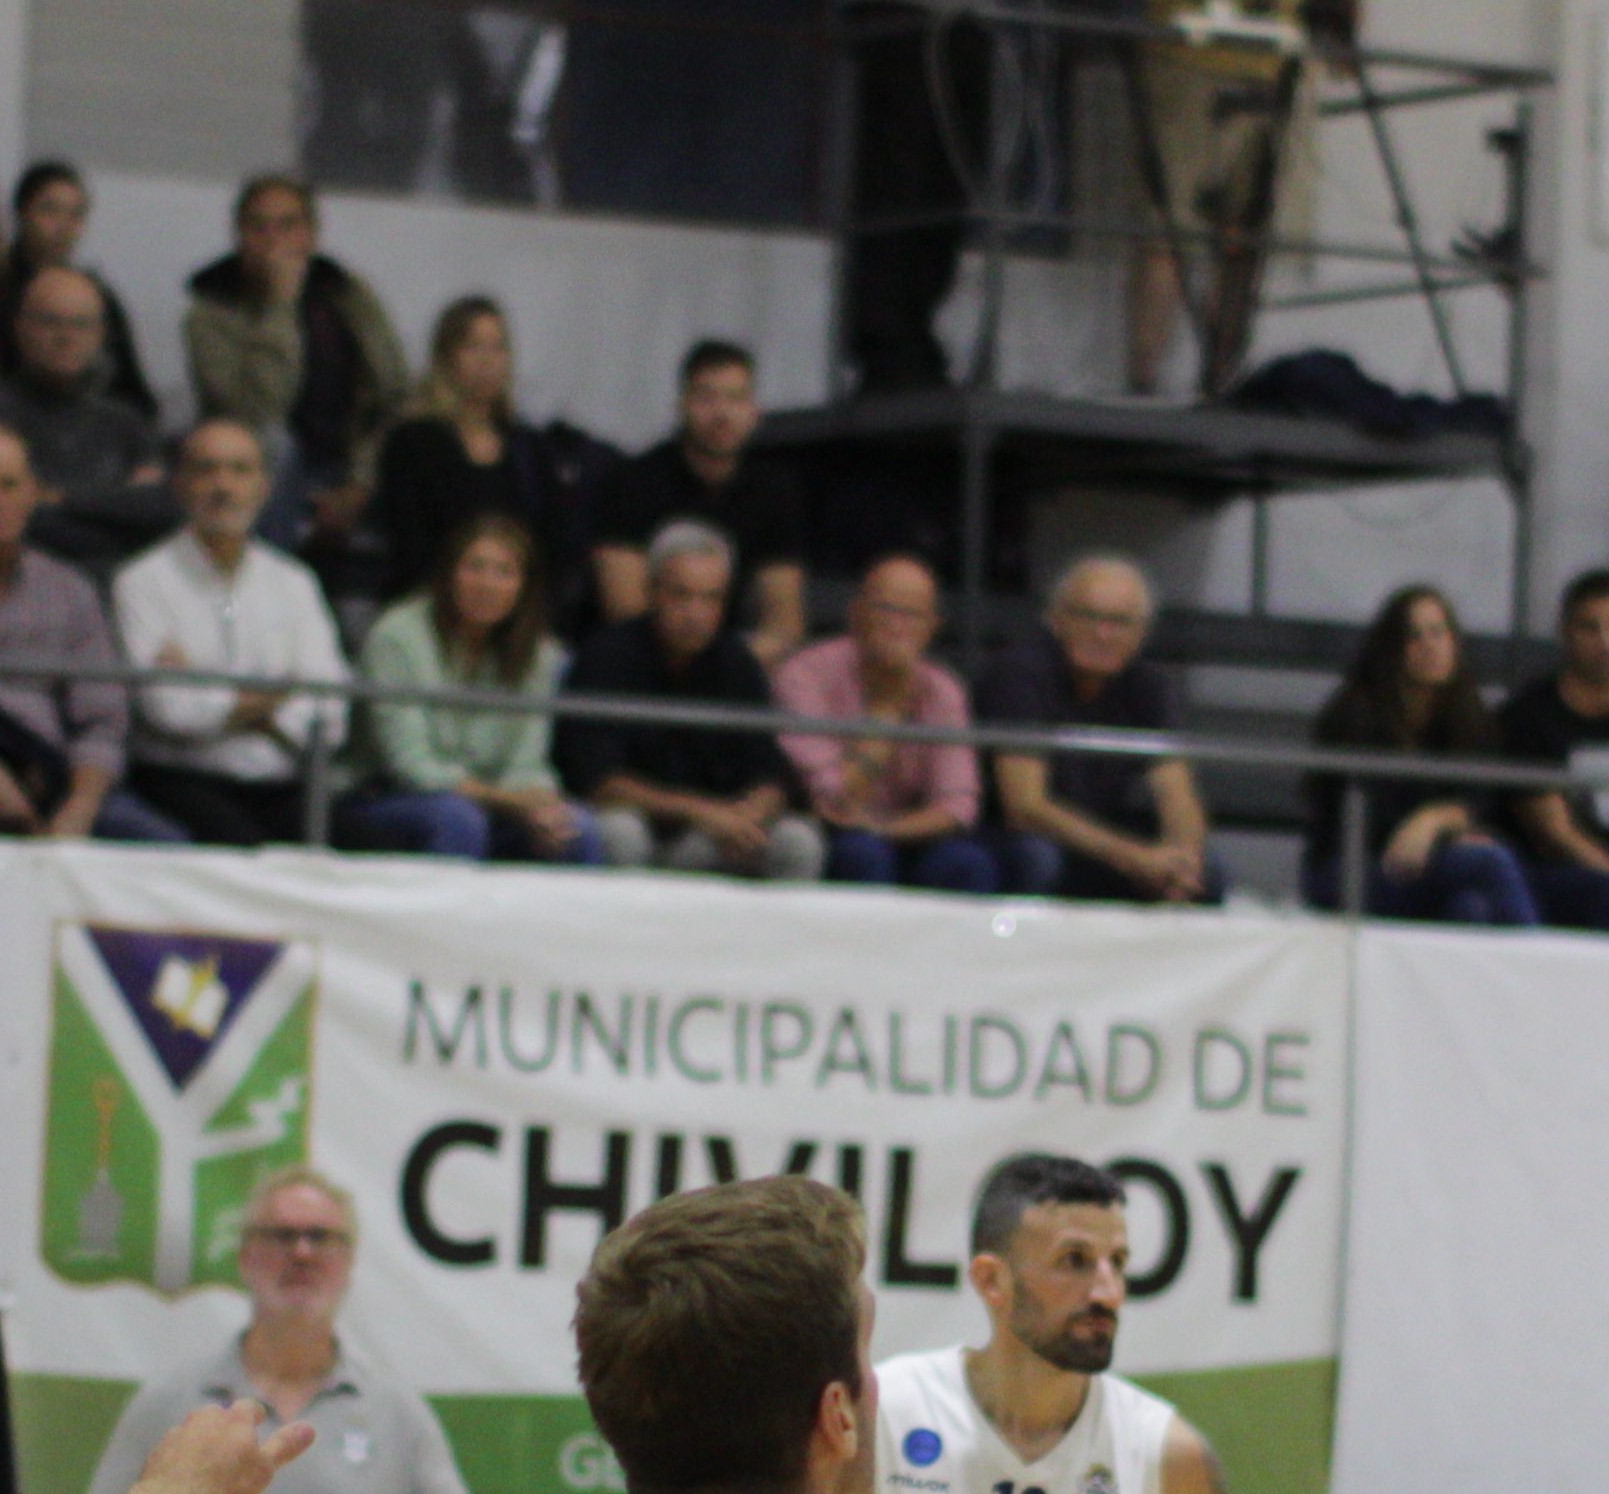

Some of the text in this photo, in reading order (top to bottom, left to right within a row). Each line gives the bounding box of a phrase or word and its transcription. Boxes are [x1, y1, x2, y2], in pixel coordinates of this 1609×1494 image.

[403, 980, 1311, 1117] MUNICIPALIDAD DE
[400, 1119, 1302, 1302] CHLOY
